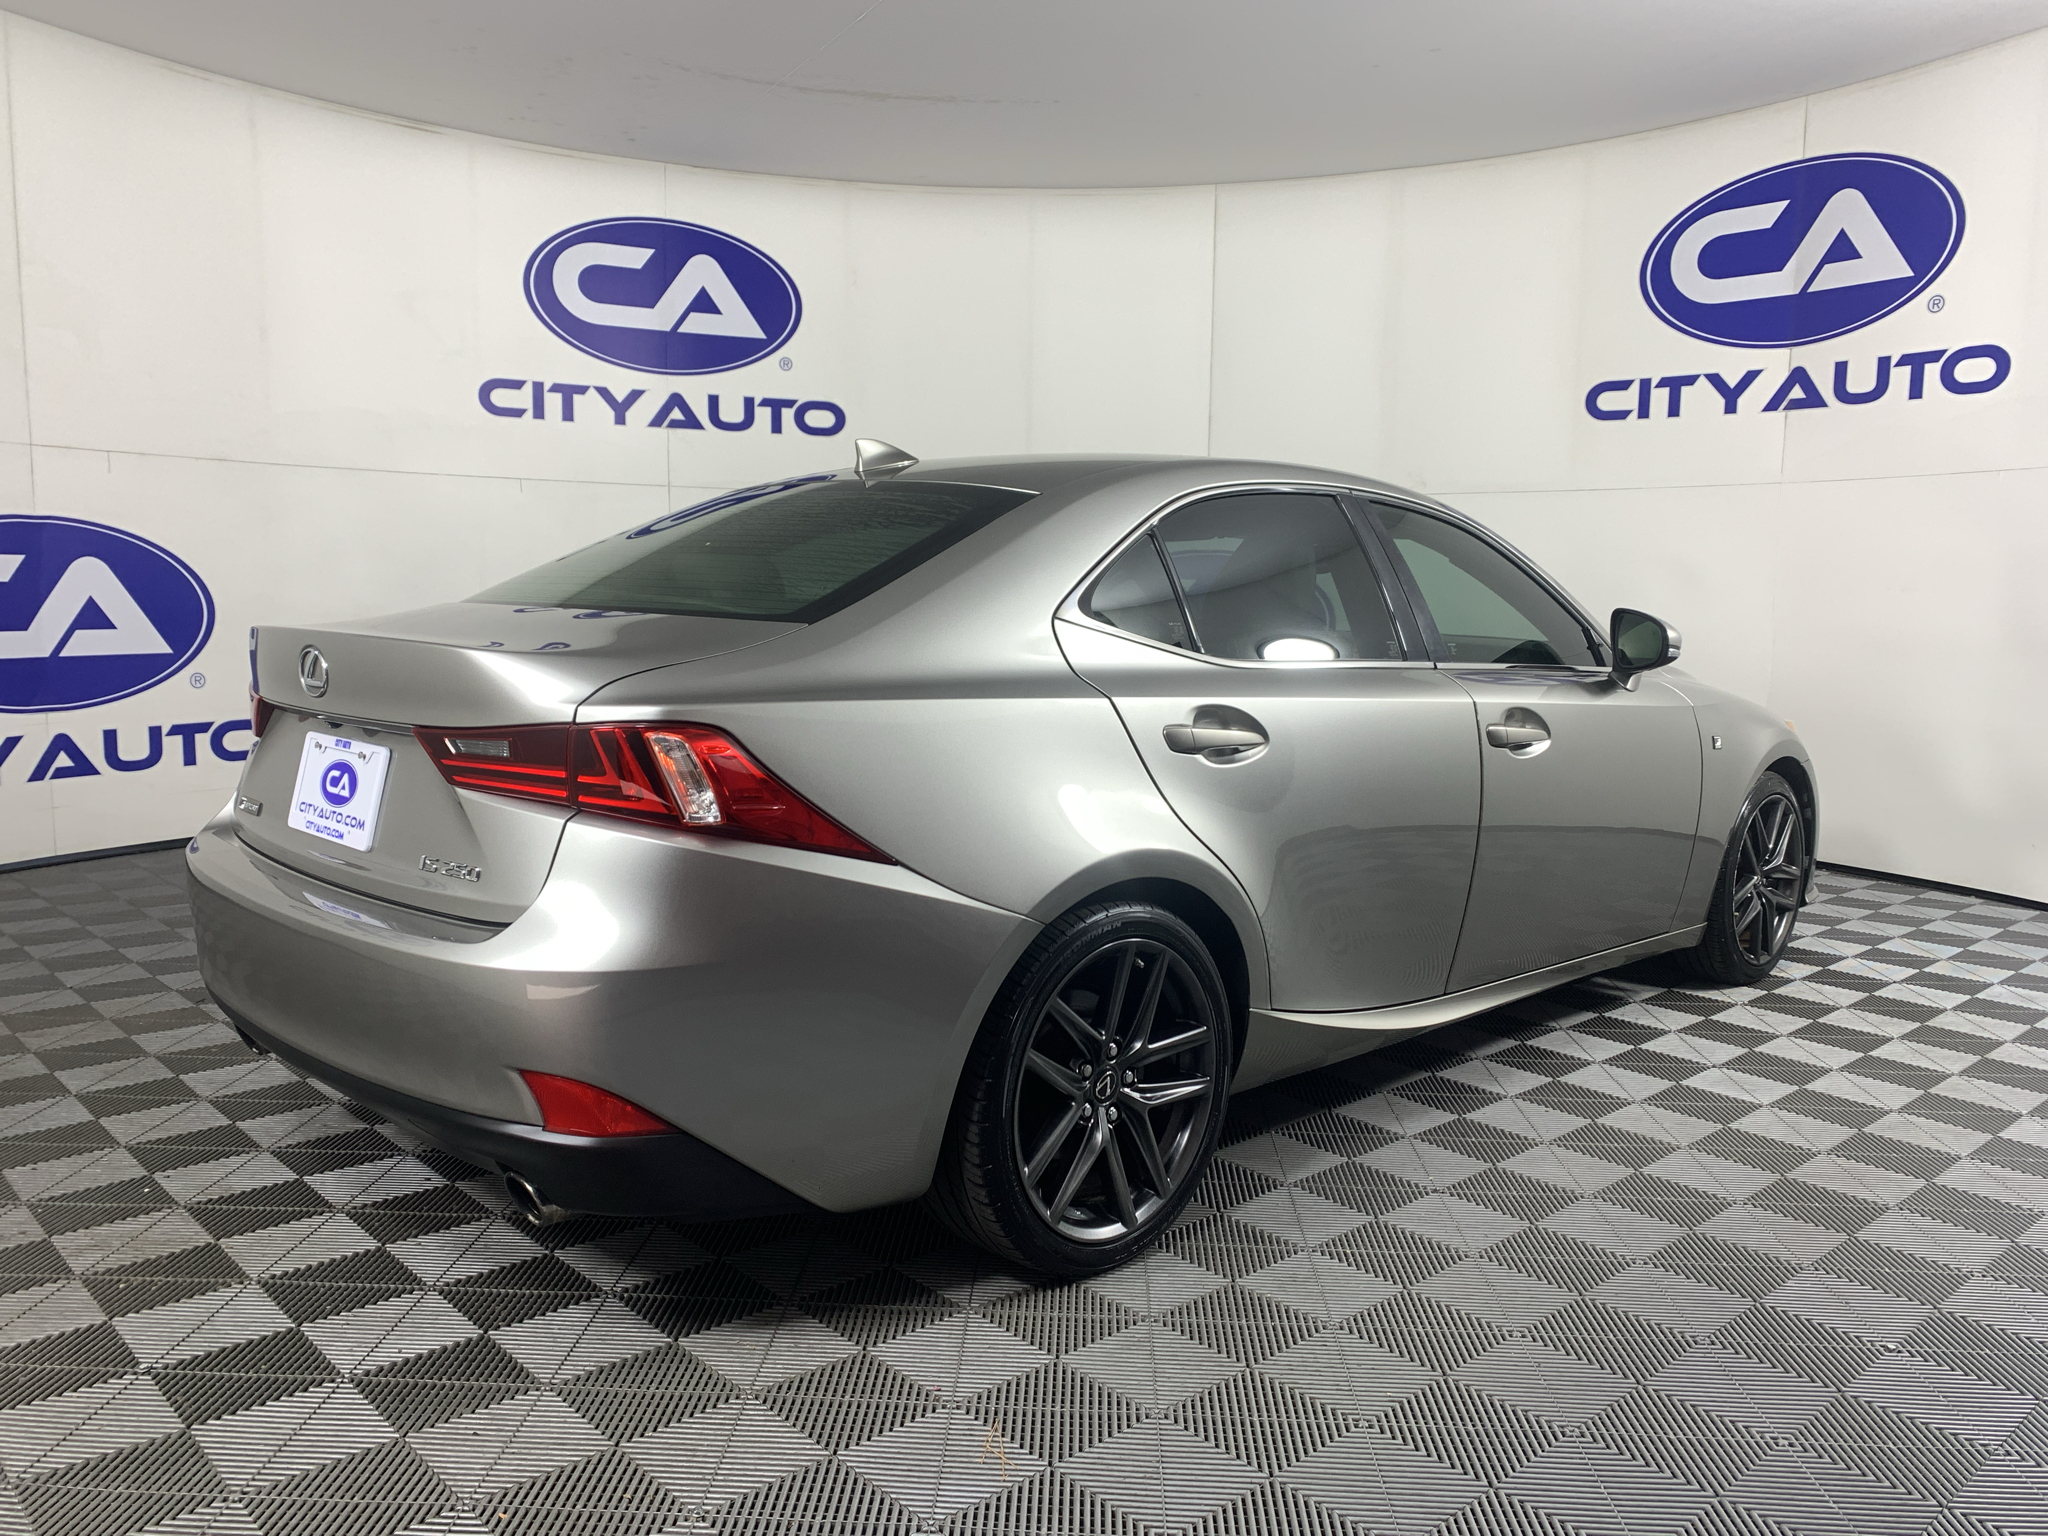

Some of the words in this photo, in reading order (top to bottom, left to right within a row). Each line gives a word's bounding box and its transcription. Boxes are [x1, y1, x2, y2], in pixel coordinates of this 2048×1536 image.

[1670, 188, 1915, 304] CA
[552, 242, 767, 339] CA
[326, 769, 350, 799] CA
[299, 802, 365, 831] CITYAUTO.COM
[419, 855, 440, 873] IS
[441, 861, 482, 882] 250
